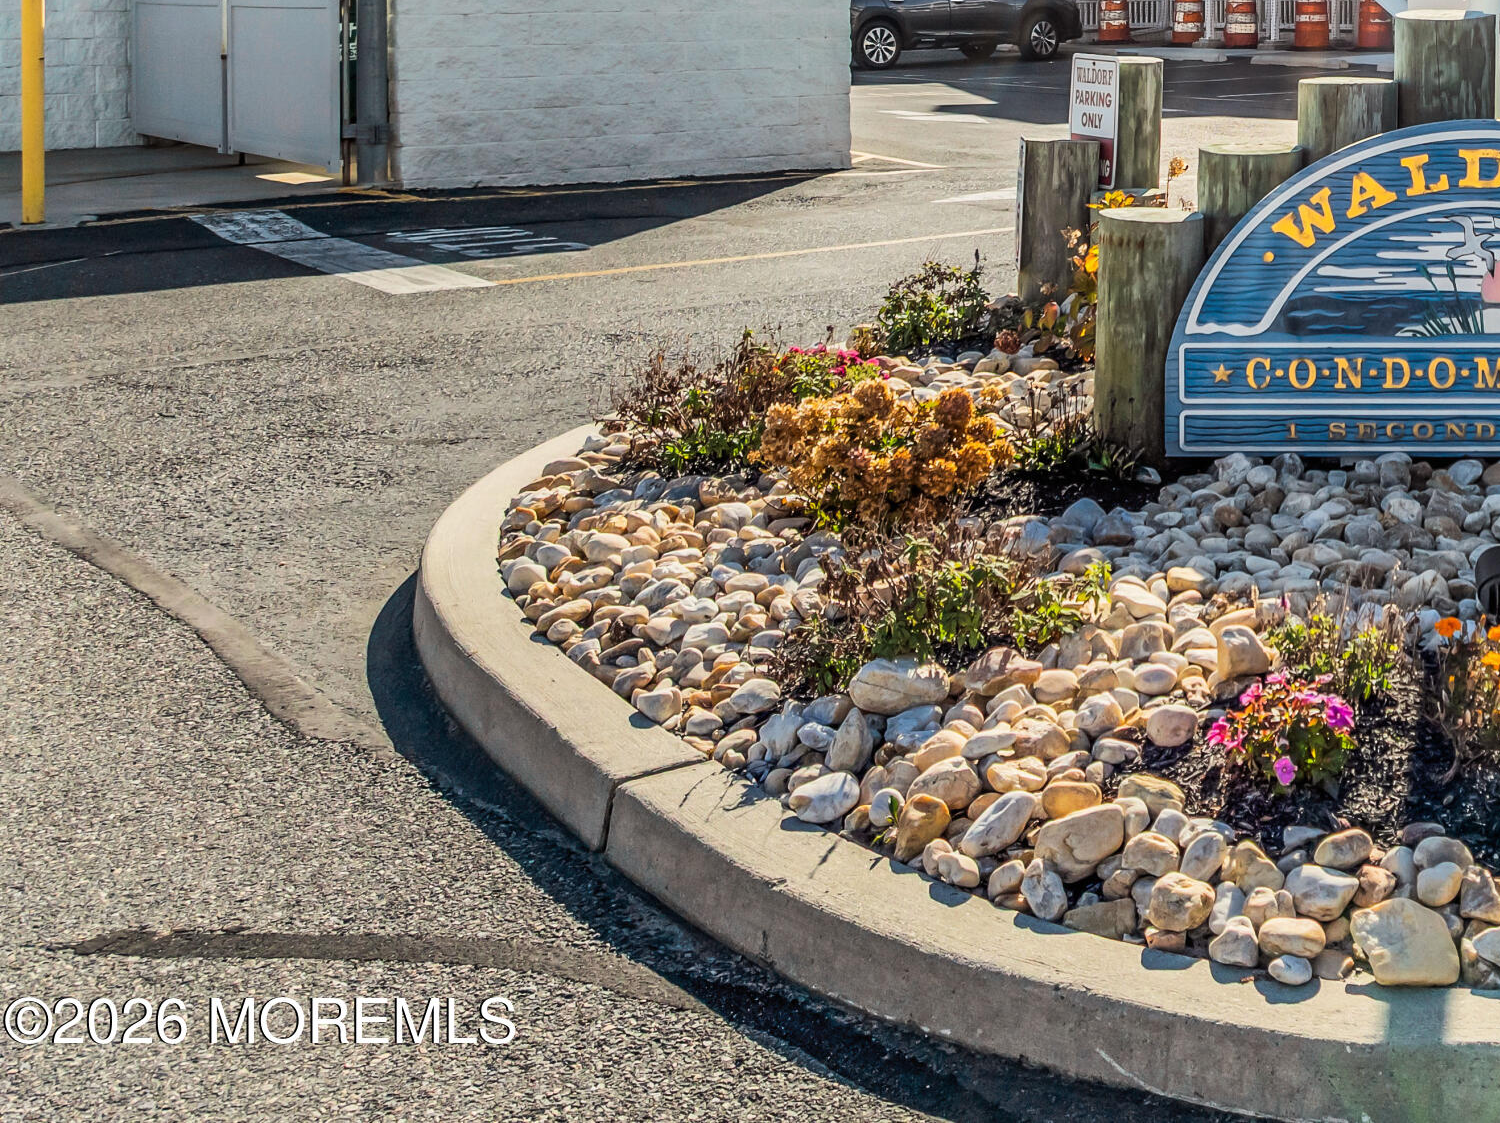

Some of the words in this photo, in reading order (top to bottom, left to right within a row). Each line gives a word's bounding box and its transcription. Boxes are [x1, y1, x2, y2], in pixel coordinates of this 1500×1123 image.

[1076, 67, 1113, 86] WALDORF
[1075, 89, 1112, 108] PARKING
[1081, 112, 1103, 129] ONLY
[1284, 422, 1298, 439] 1
[1328, 422, 1496, 440] SECOND
